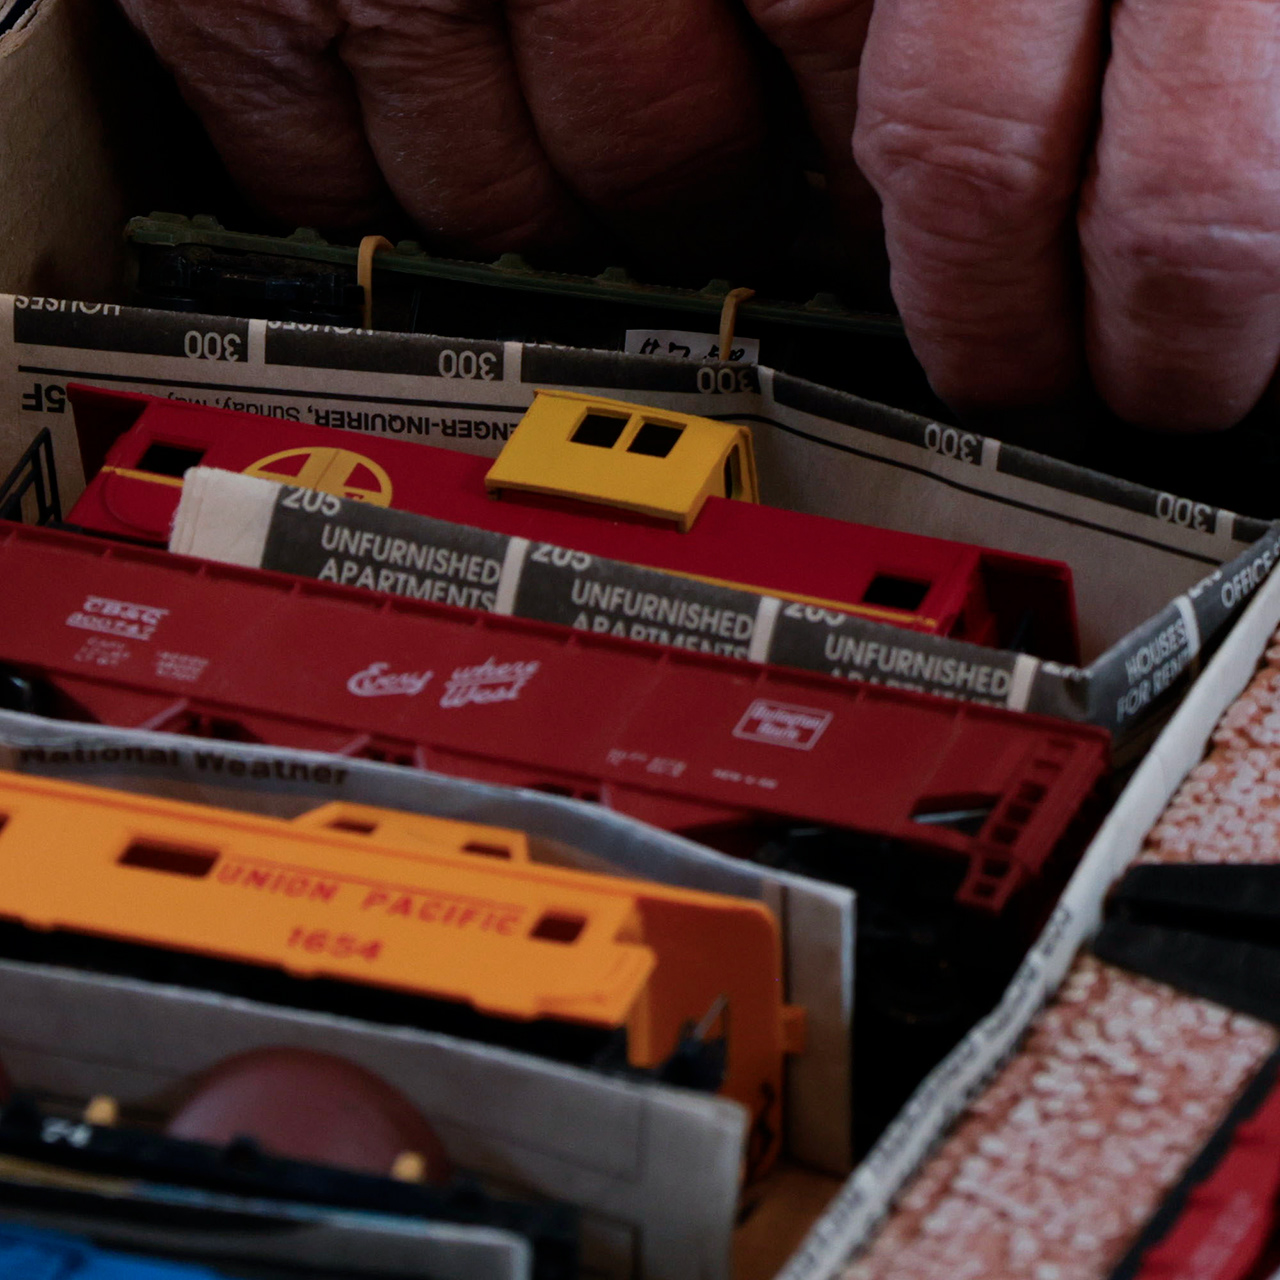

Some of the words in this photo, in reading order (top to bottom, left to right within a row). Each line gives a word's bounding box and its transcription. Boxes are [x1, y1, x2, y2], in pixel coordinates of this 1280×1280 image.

[183, 330, 243, 362] 300
[438, 348, 499, 381] 300
[22, 383, 67, 413] 5F
[696, 365, 754, 395] 300
[923, 423, 979, 463] 300
[1155, 493, 1212, 532] 300
[320, 523, 501, 586] UNFURNISHED
[571, 578, 754, 641] UNFURNISHED
[824, 632, 1013, 698] UNFURNISHED
[1124, 618, 1189, 683] HOUSES
[1117, 676, 1153, 722] FOR
[18, 741, 181, 767] National
[193, 750, 351, 786] Weather
[217, 863, 339, 902] UNION
[362, 891, 521, 937] PACIFIC
[287, 926, 384, 962] 1654
